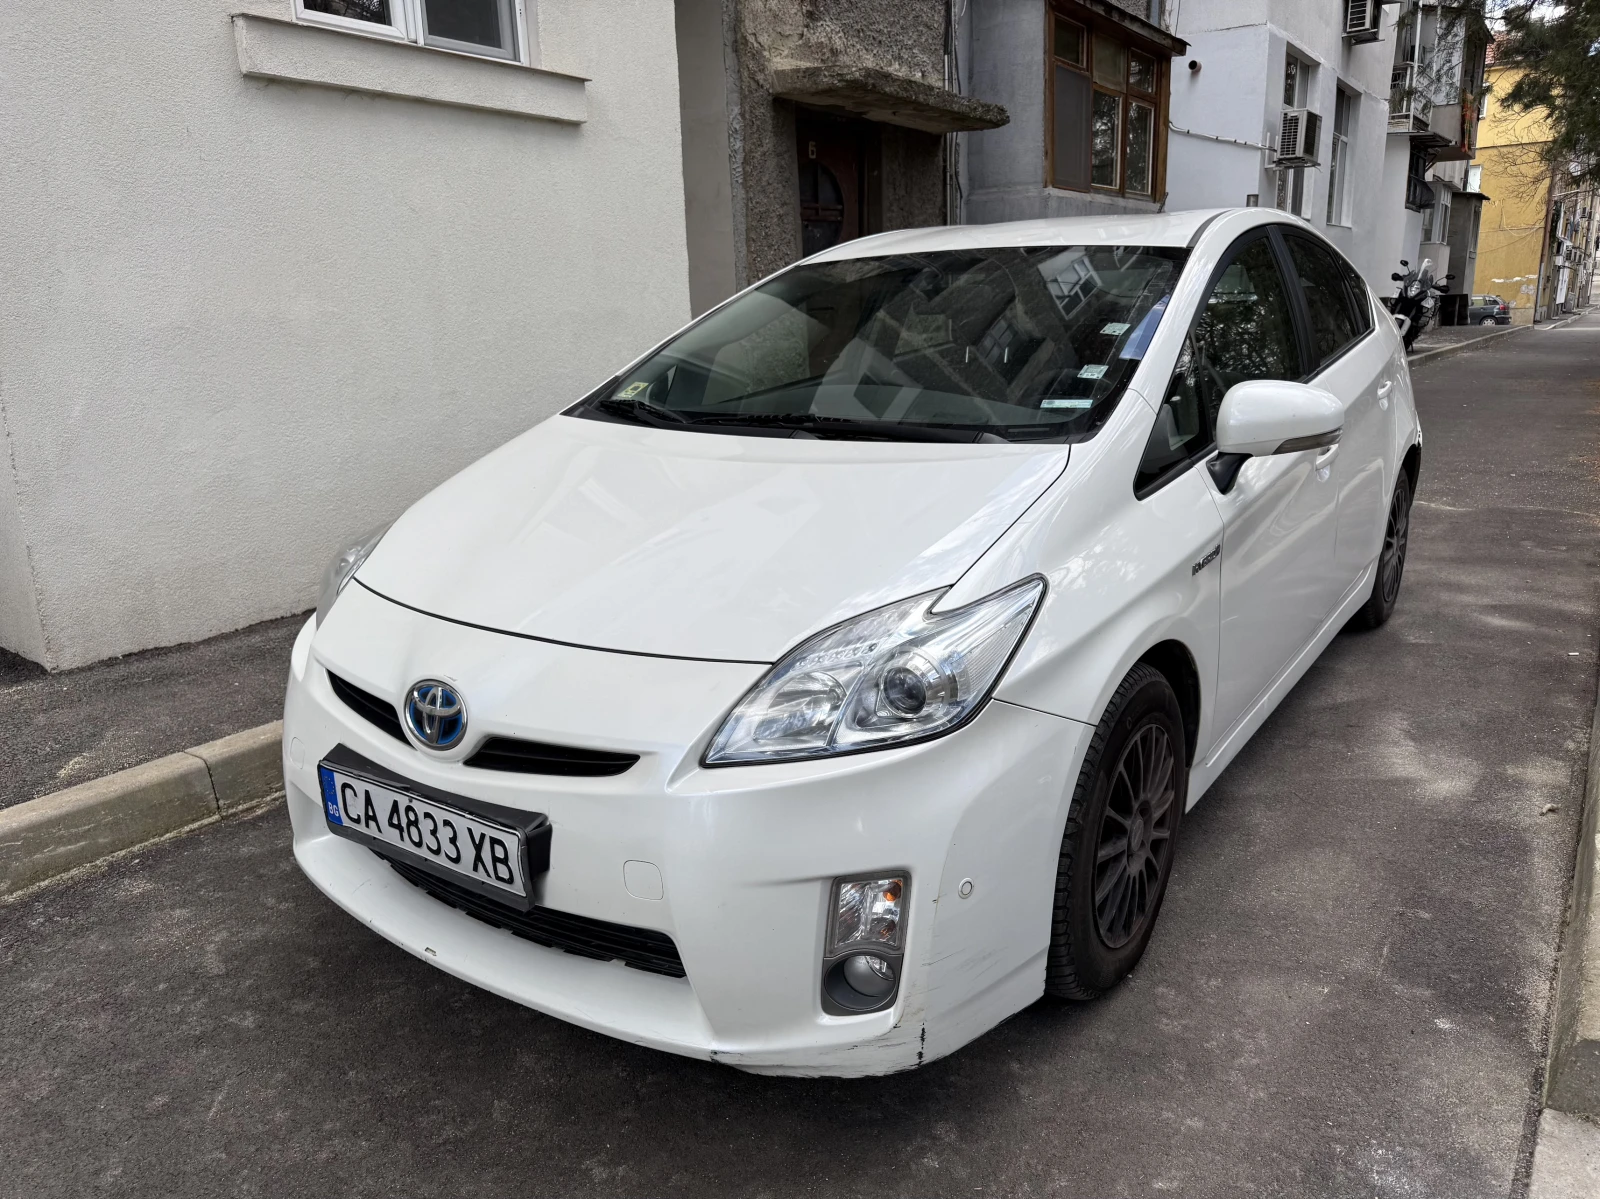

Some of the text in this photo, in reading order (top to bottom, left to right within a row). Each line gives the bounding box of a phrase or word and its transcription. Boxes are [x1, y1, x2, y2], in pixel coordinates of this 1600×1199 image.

[808, 140, 817, 159] 6
[327, 801, 340, 817] BG
[340, 782, 515, 885] CA 4833 XB
